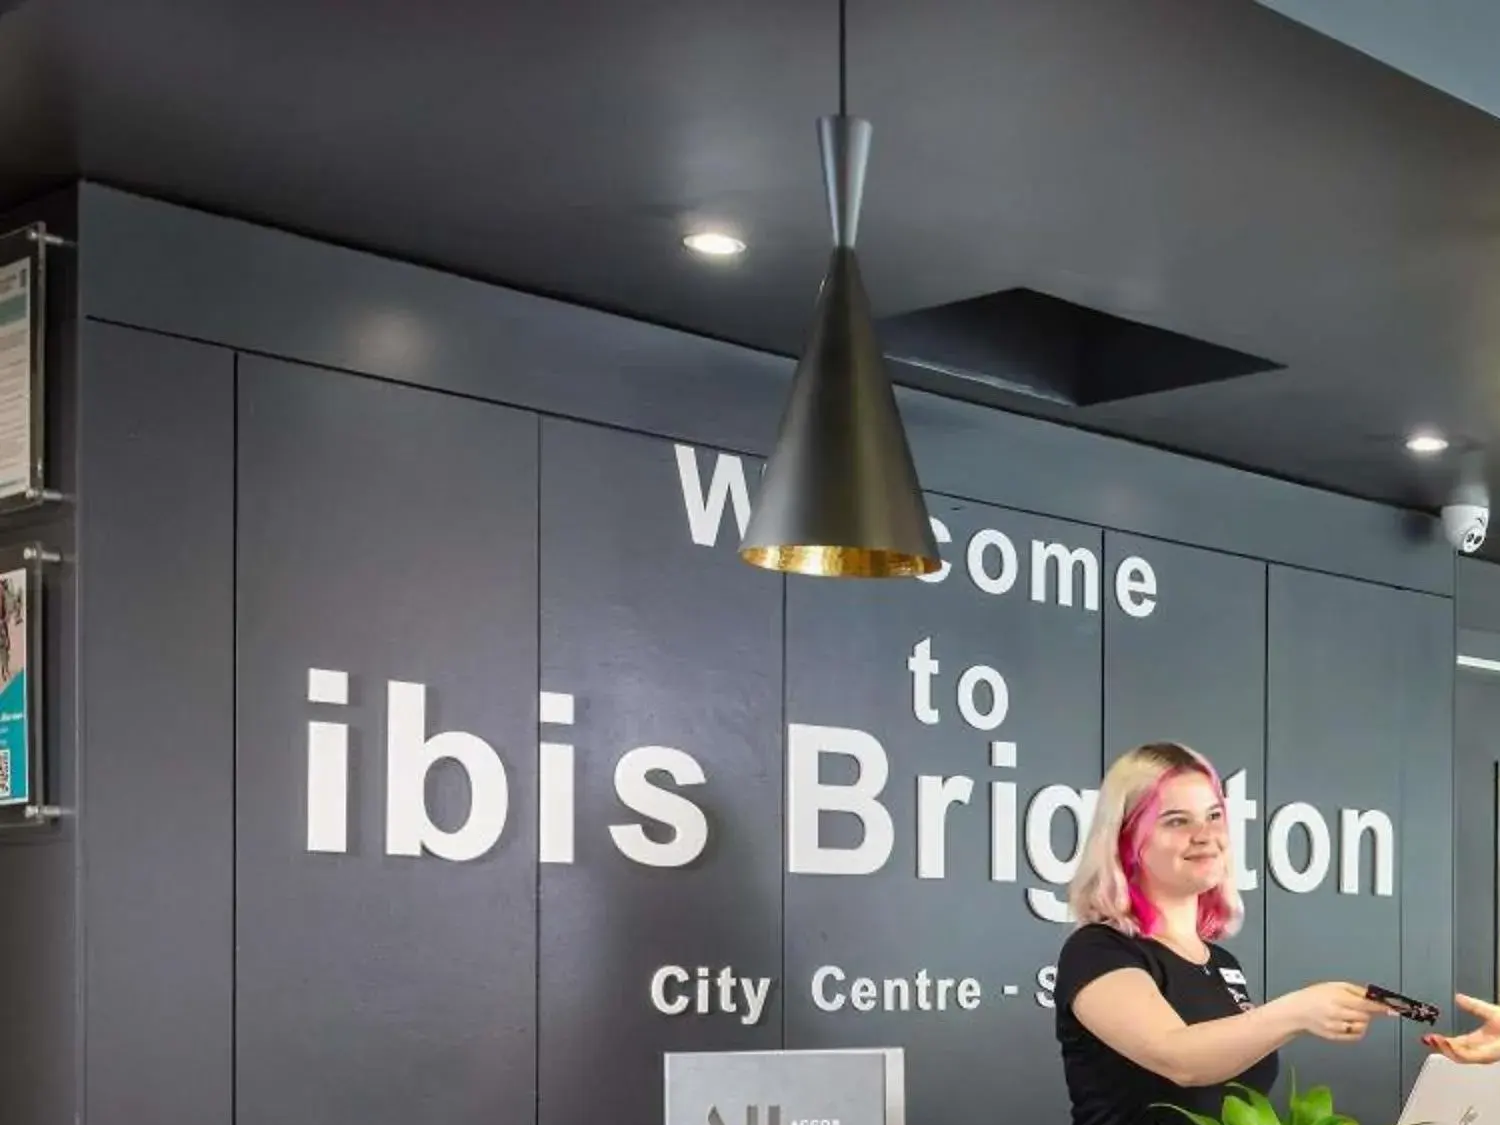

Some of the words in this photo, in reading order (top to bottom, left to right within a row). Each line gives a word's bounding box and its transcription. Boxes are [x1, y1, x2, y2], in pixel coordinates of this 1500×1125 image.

[908, 636, 1009, 731] to
[307, 667, 709, 868] ibis
[787, 722, 1394, 923] Brigton
[650, 964, 772, 1025] City
[810, 965, 982, 1013] Centre
